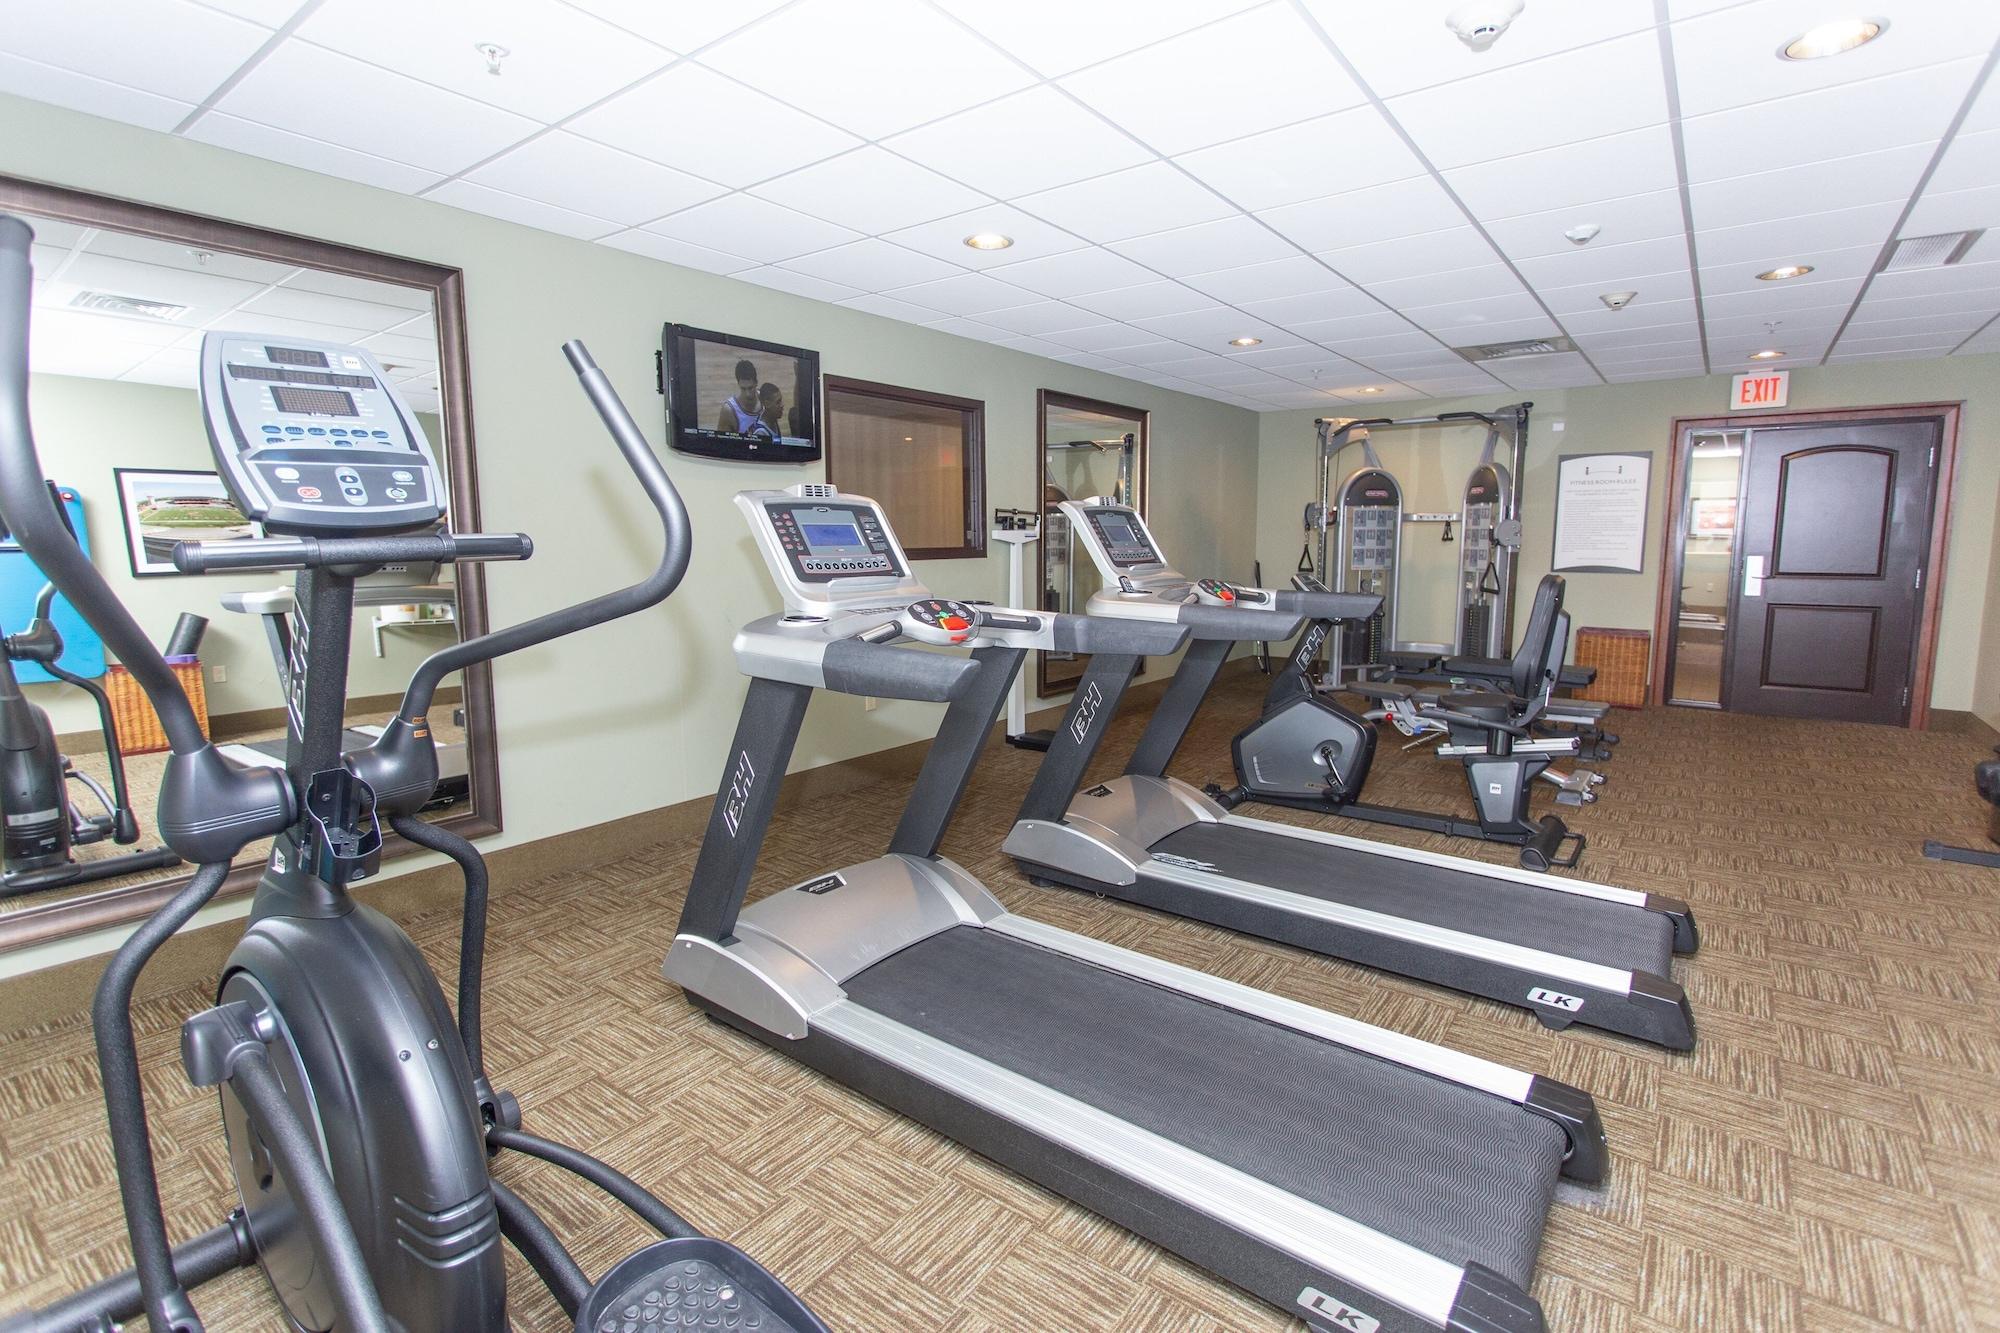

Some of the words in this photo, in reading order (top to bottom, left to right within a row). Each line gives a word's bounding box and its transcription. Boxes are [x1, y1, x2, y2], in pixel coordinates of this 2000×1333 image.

[1741, 377, 1781, 403] EXIT
[1296, 625, 1326, 672] BH
[1070, 681, 1102, 745] BH
[723, 750, 755, 838] BH
[1537, 991, 1572, 1008] LK
[1311, 1295, 1365, 1330] LK
